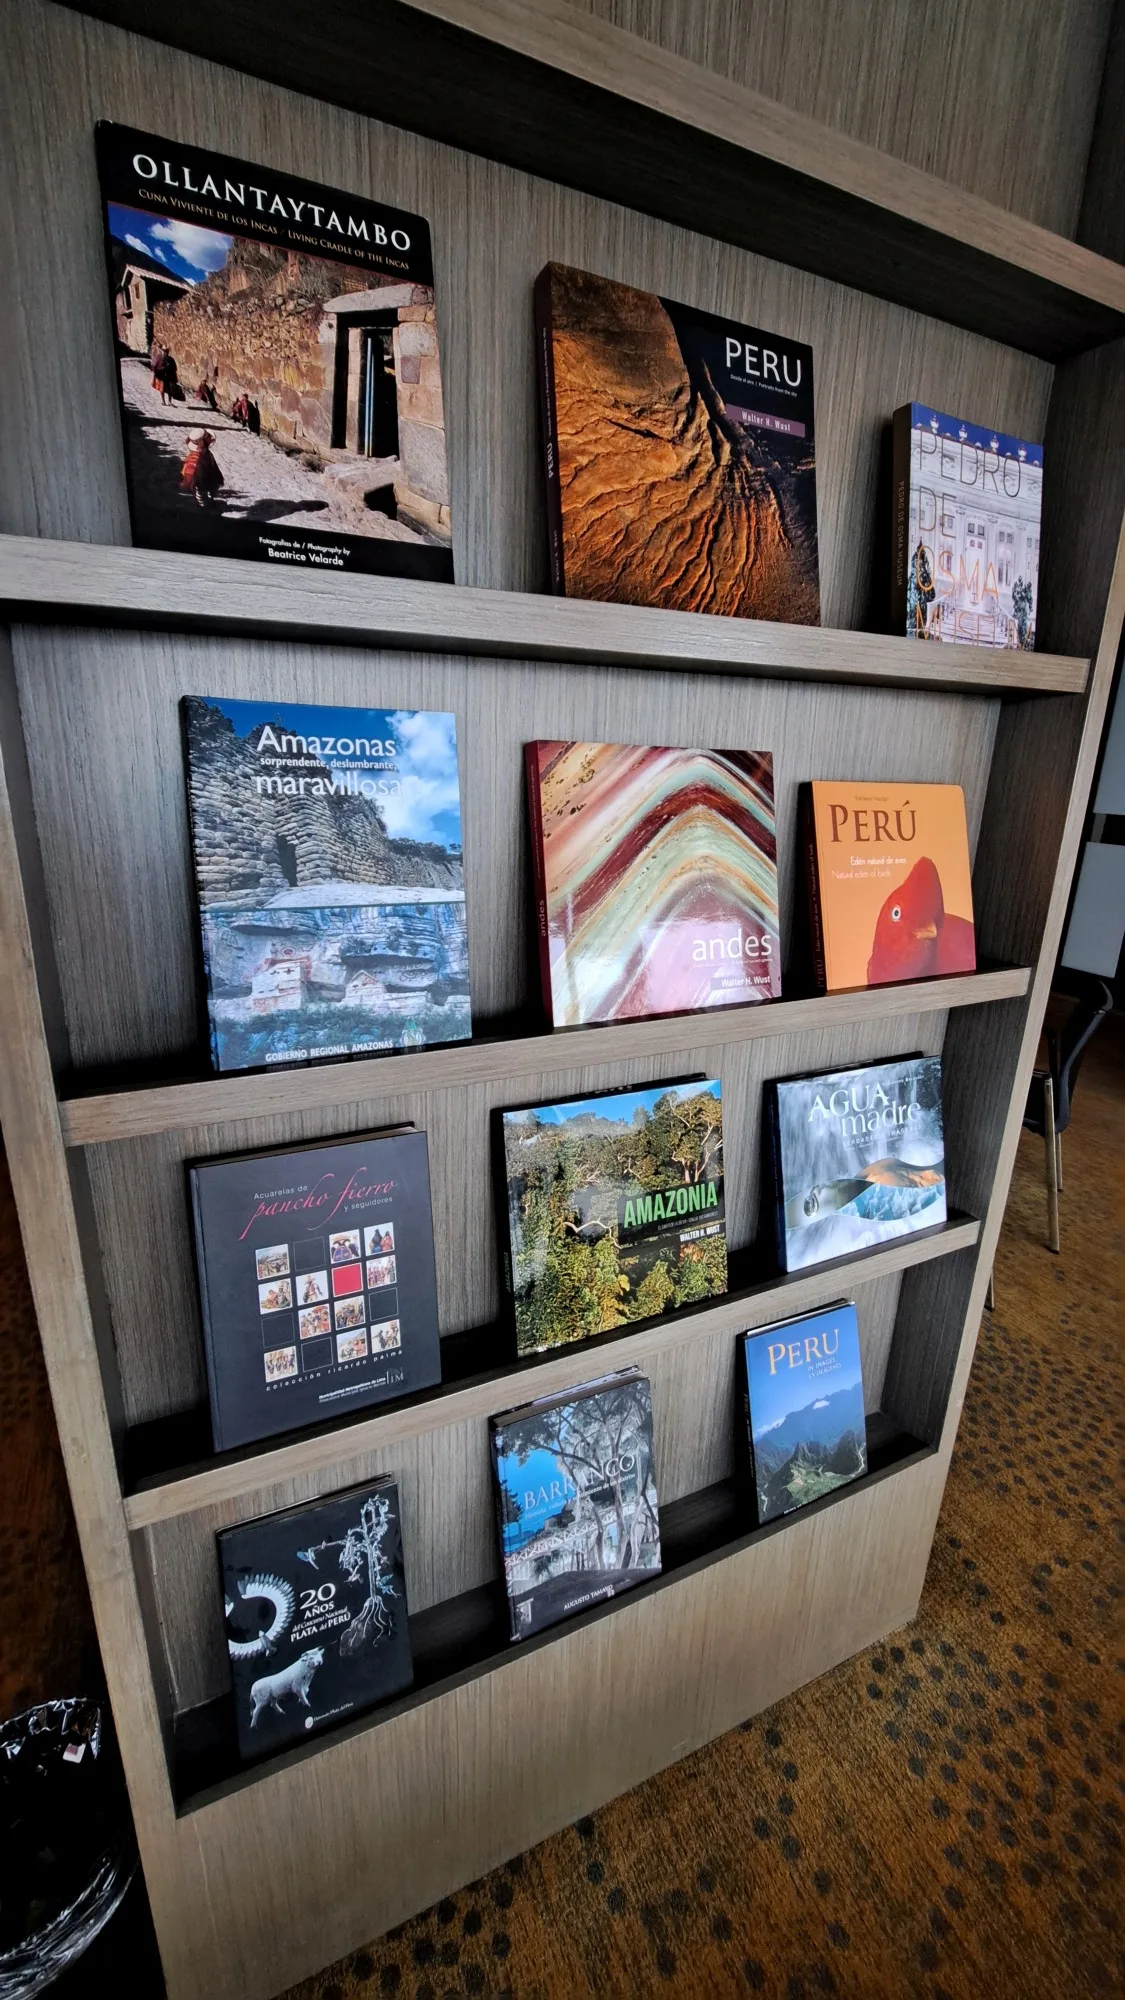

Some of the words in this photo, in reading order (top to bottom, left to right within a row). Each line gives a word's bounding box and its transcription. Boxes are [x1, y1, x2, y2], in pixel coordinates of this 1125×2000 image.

[132, 153, 411, 251] OLLANTAYTAMBO
[138, 188, 169, 205] CUNA
[170, 197, 214, 217] VIVIENTE
[217, 210, 229, 221] DE
[231, 213, 248, 226] LOS
[250, 218, 278, 235] INCAS
[287, 229, 318, 246] LIVING
[319, 238, 352, 255] CRADLE
[354, 248, 365, 259] OF
[367, 251, 383, 263] THE
[384, 254, 410, 270] INCAS
[726, 336, 802, 387] PERU
[741, 411, 764, 425] Walter
[765, 417, 773, 427] H.
[774, 420, 791, 432] Wust
[546, 442, 554, 478] PERU
[919, 430, 1021, 498] PEDRO
[918, 486, 957, 538] DE
[268, 547, 307, 561] Beatrice
[308, 552, 344, 566] Velarde
[293, 540, 301, 549] de
[307, 543, 342, 555] Photography
[342, 547, 351, 556] by
[916, 545, 999, 601] OSMA
[256, 725, 397, 757] Amazonas
[260, 756, 330, 769] sorprendente,
[330, 758, 398, 771] deslumbrante,
[256, 770, 402, 796] maravillosa
[827, 799, 917, 843] PERÚ
[538, 899, 547, 937] andes
[692, 928, 773, 961] andes
[721, 978, 745, 988] Walter
[745, 977, 752, 985] H.
[753, 975, 771, 984] Wust
[265, 1049, 308, 1063] GOBIERNO
[309, 1045, 350, 1057] REGIONAL
[351, 1039, 394, 1053] AMAZONAS
[808, 1082, 889, 1123] AGUA
[841, 1101, 921, 1137] madre
[238, 1173, 335, 1241] pancho
[306, 1167, 398, 1231] fierro
[253, 1186, 295, 1200] Acuarelas
[297, 1184, 308, 1193] de
[343, 1204, 349, 1213] y
[351, 1196, 393, 1210] seguidores
[623, 1181, 718, 1229] AMAZONIA
[680, 1230, 700, 1243] WALTER
[706, 1224, 720, 1236] WUST
[768, 1328, 839, 1376] PERU
[815, 1356, 836, 1369] IMAGES
[266, 1372, 321, 1392] colección
[327, 1359, 367, 1375] ricardo
[373, 1350, 403, 1363] palma
[523, 1453, 635, 1510] BARRANCO
[299, 1582, 336, 1610] 20
[303, 1600, 335, 1620] AÑOS
[563, 1594, 590, 1611] AUGUSTO
[590, 1584, 613, 1599] TAMAYO
[290, 1626, 318, 1643] PLATA
[318, 1622, 328, 1632] del
[327, 1611, 351, 1629] PERÚ
[291, 1623, 300, 1633] del
[300, 1615, 325, 1630] Concurso
[324, 1605, 348, 1621] Nacional
